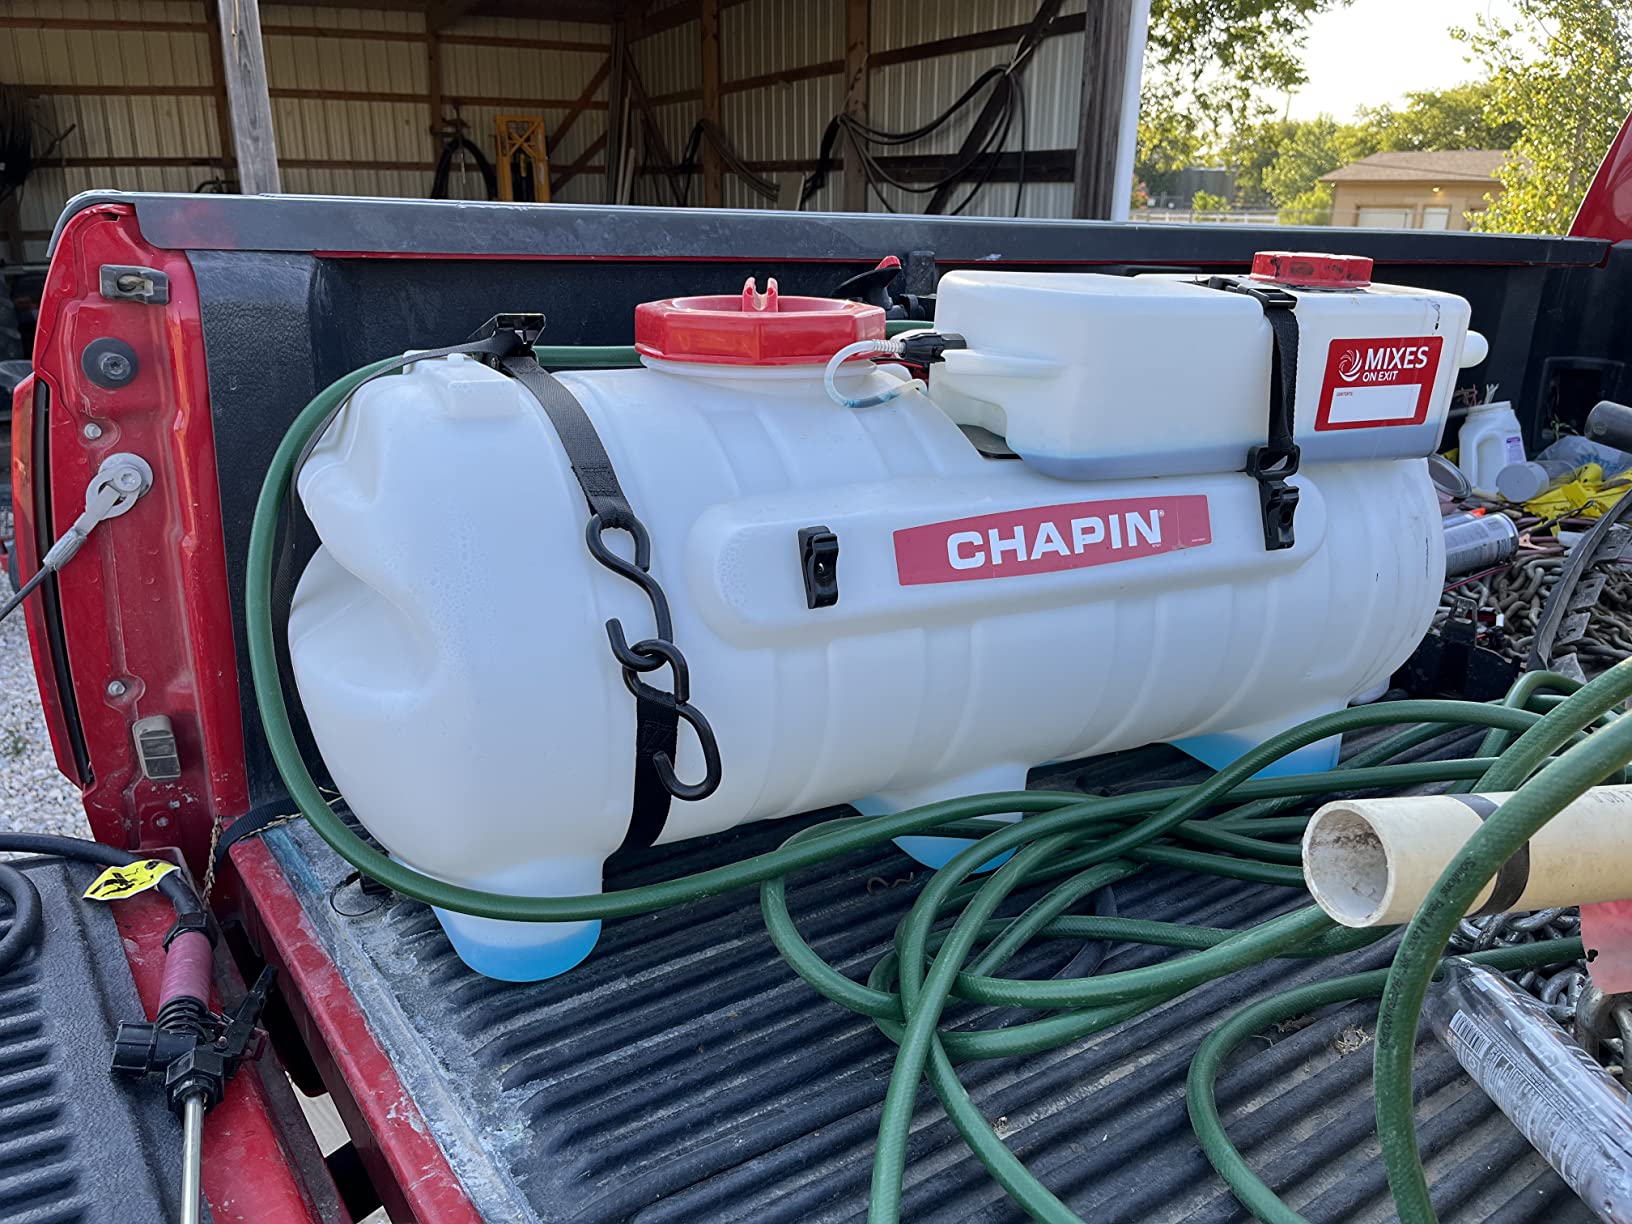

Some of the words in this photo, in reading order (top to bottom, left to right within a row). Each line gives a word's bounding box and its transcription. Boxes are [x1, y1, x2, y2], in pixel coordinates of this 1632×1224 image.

[1365, 346, 1429, 370] MIXES
[1362, 372, 1376, 382] ON
[1378, 371, 1398, 381] EXIT
[1440, 856, 1476, 898] Solutions
